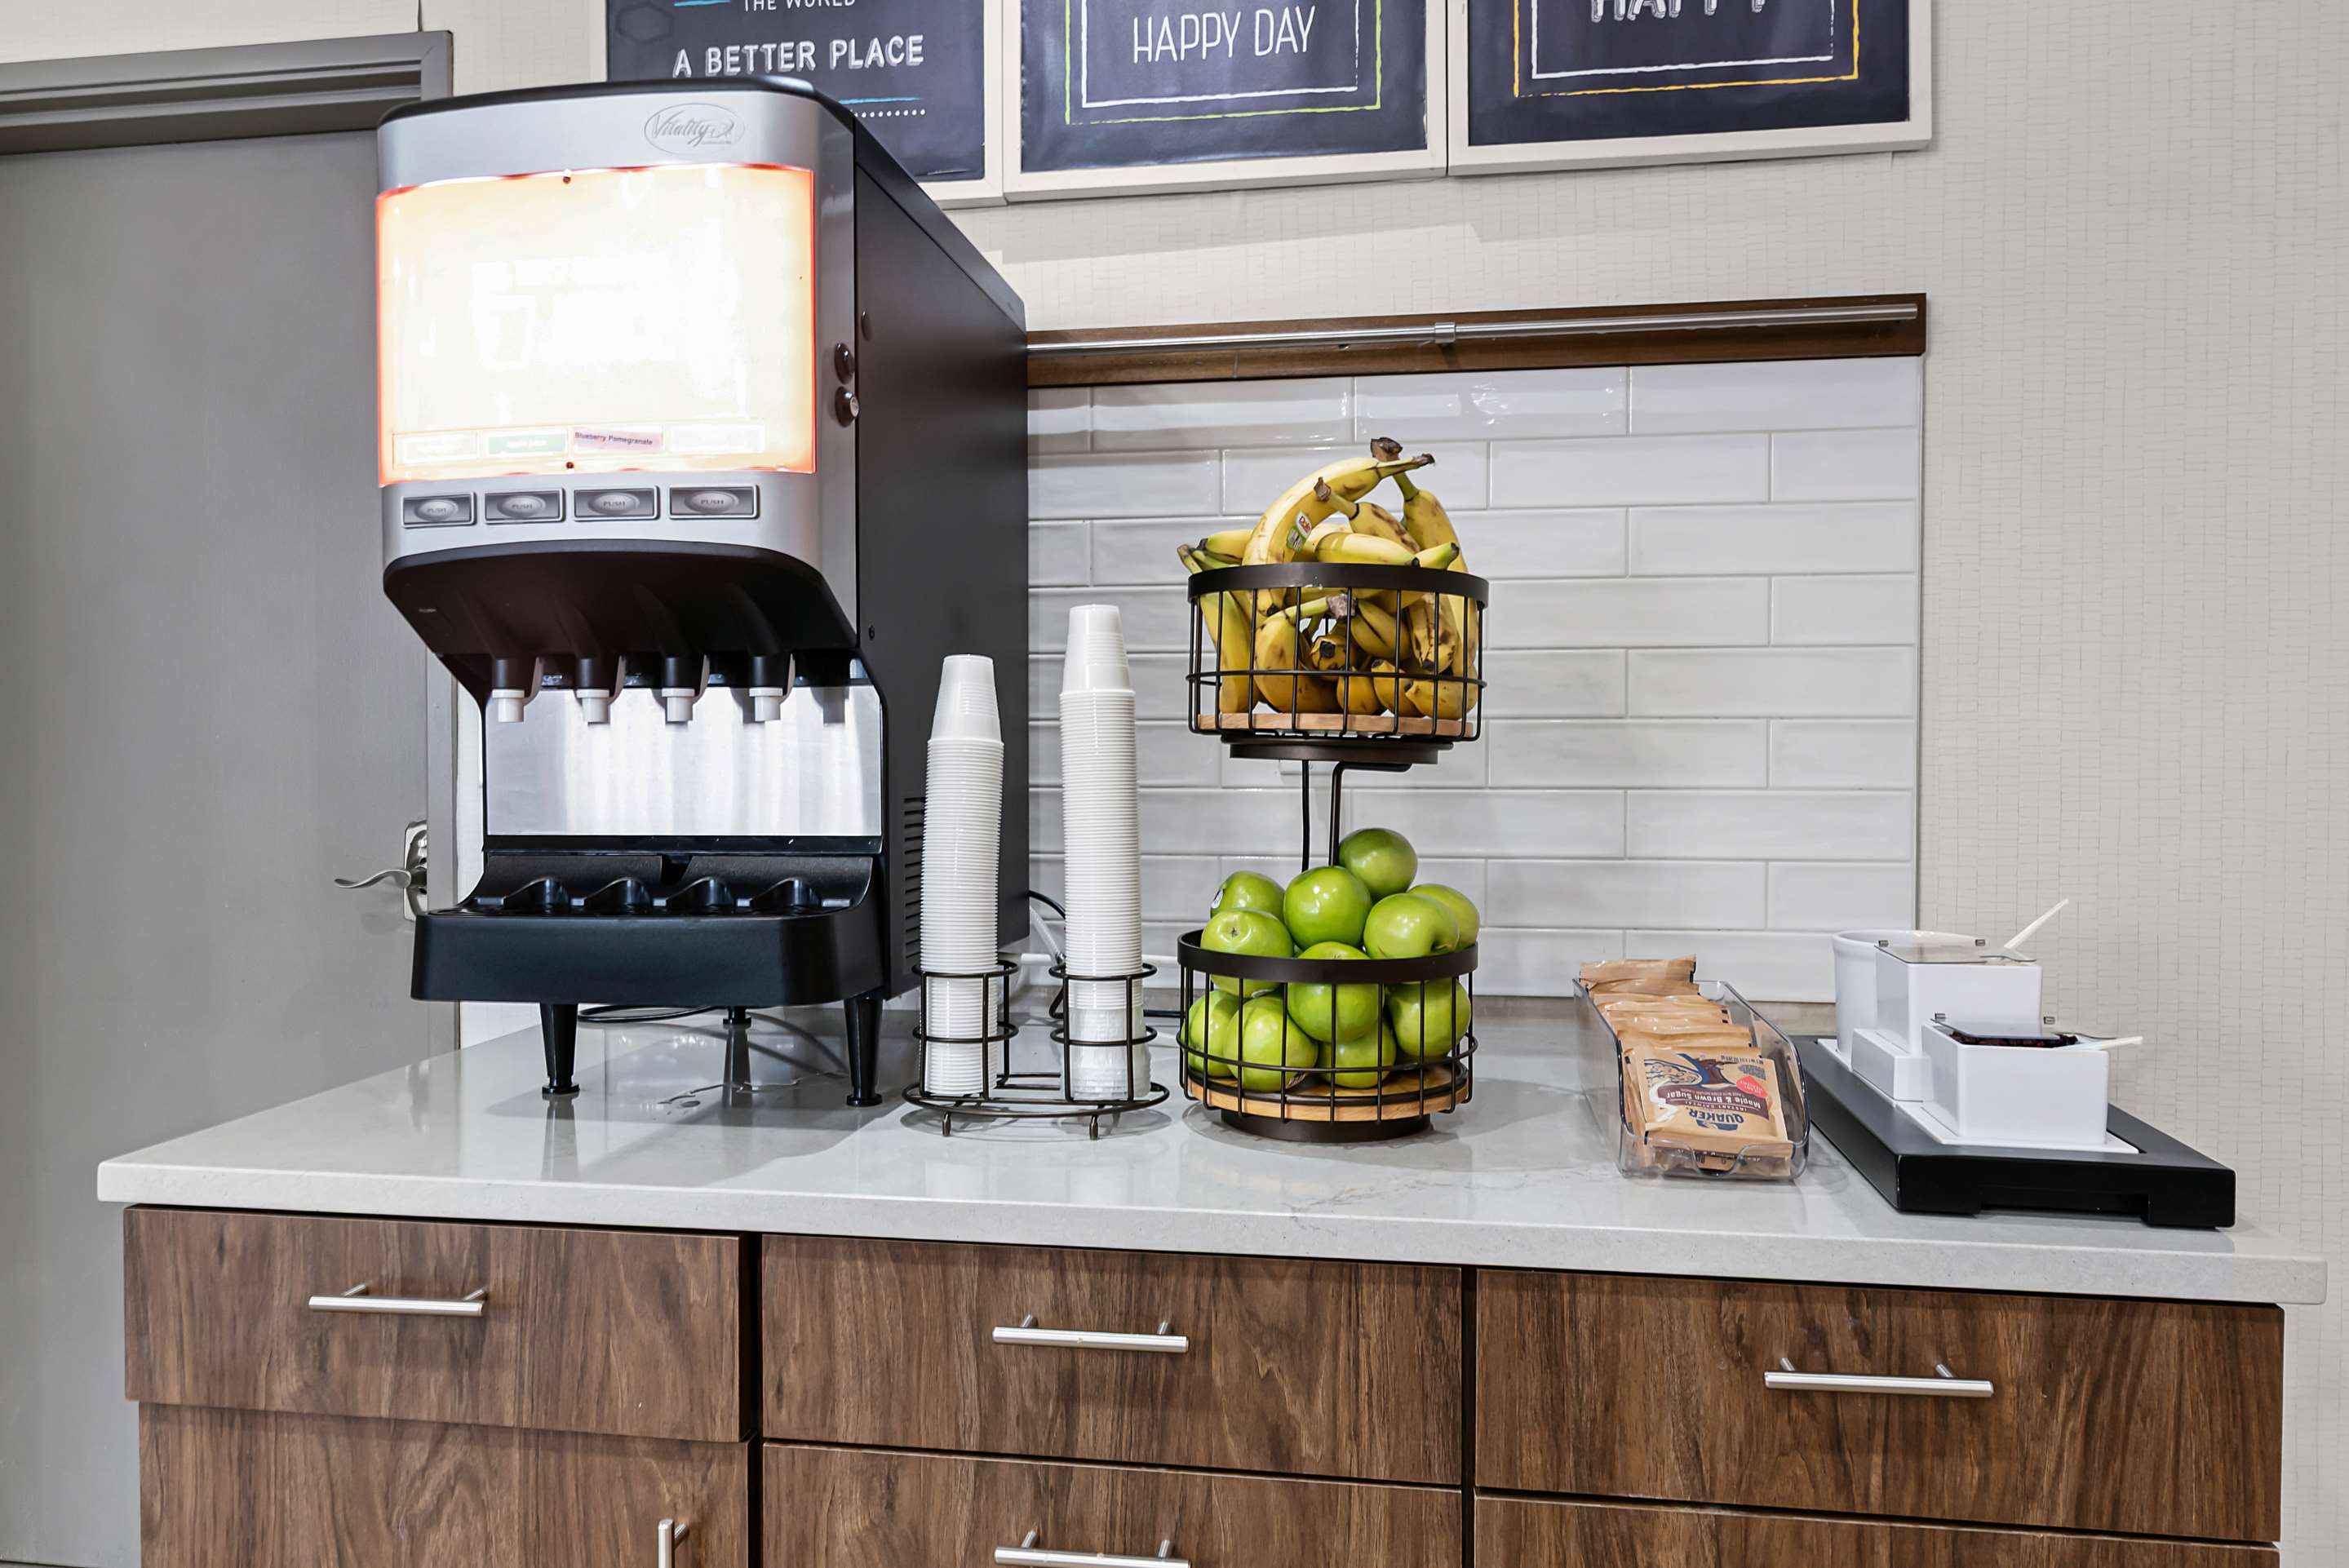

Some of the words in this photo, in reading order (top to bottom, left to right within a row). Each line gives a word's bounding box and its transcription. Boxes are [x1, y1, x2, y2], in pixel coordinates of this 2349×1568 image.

[1132, 11, 1241, 64] HAPPY
[1254, 6, 1315, 57] DAY
[672, 49, 692, 78] A
[705, 40, 816, 76] BETTER
[830, 34, 924, 70] PLACE
[574, 432, 606, 442] Blueberry
[608, 435, 654, 445] Pomegranate
[1666, 1092, 1693, 1101] Sugar
[1695, 1095, 1723, 1103] Brown
[1735, 1097, 1761, 1110] Maple
[1688, 1109, 1744, 1123] QUAKER
